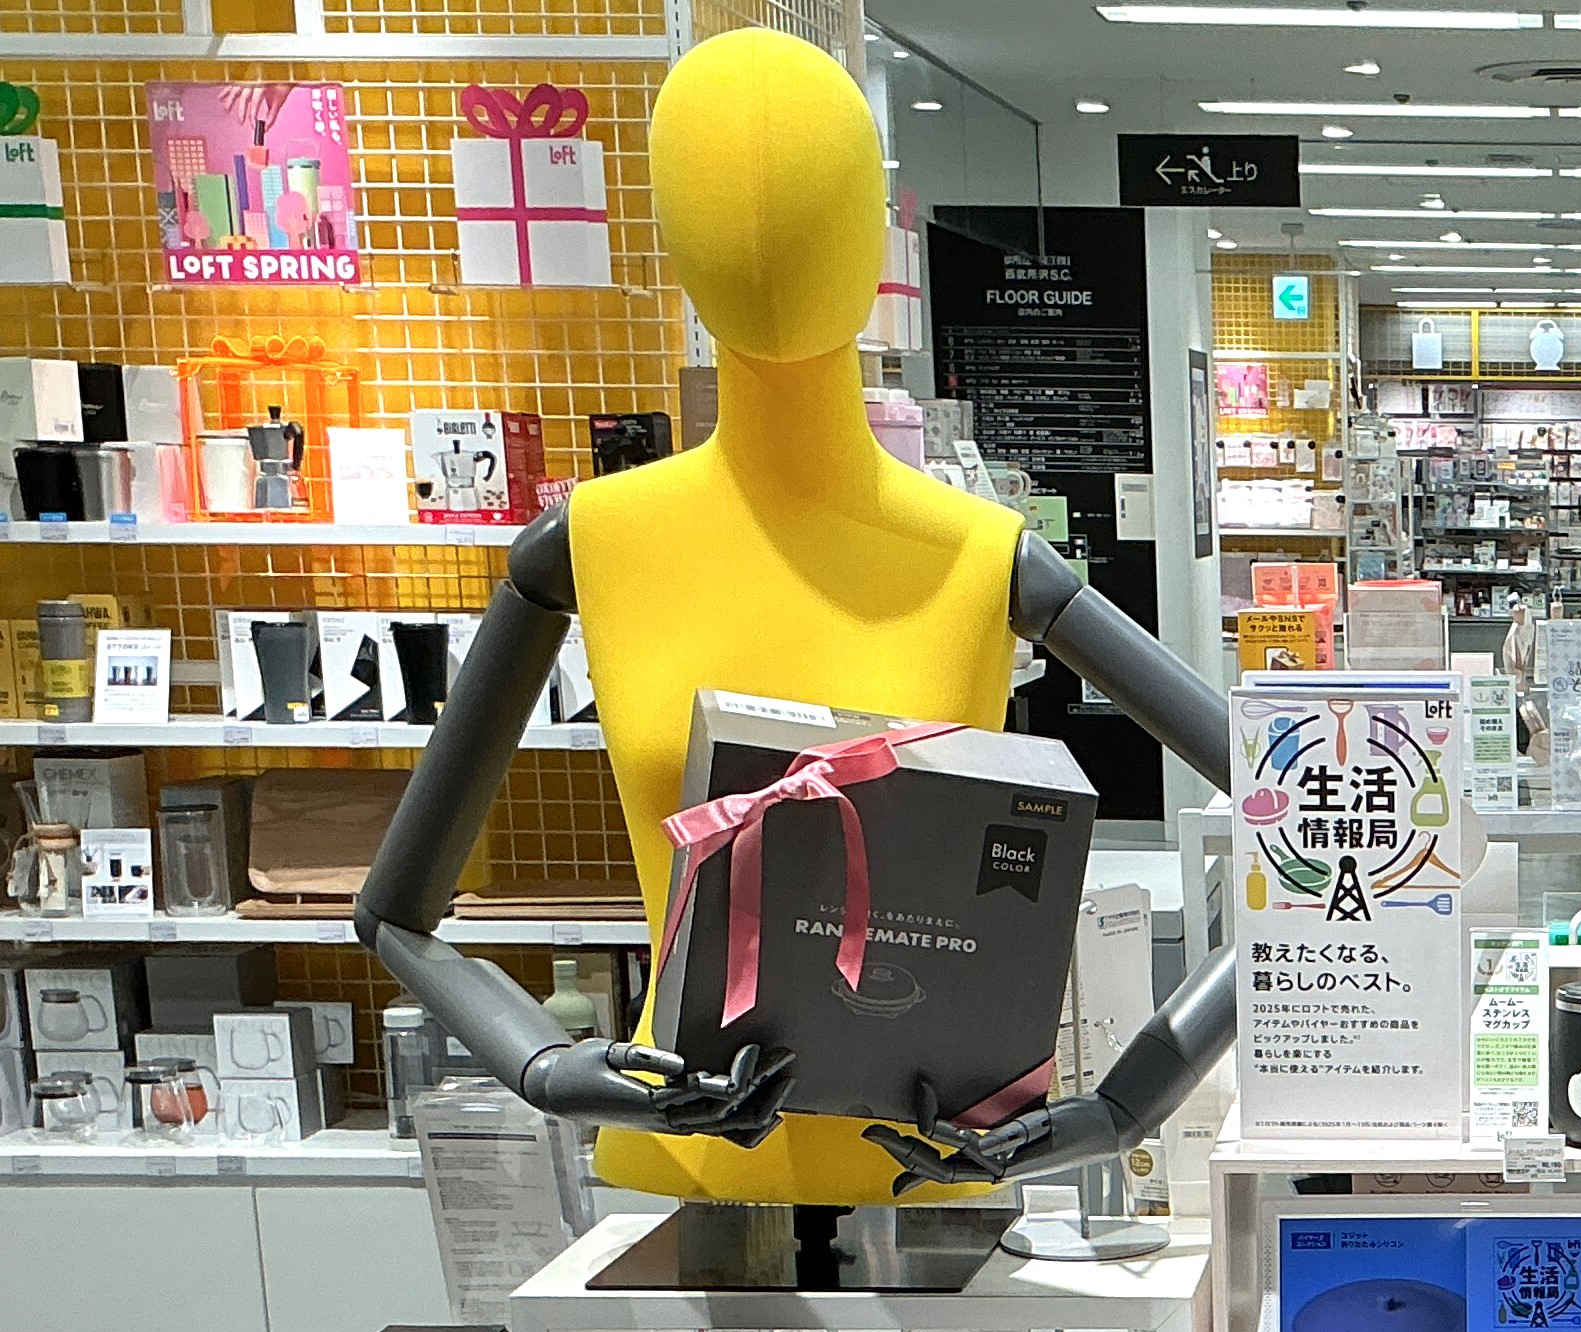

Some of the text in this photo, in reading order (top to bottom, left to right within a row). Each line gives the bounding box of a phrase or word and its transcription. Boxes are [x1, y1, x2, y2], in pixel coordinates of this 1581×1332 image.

[4, 141, 35, 164] Loft
[549, 143, 577, 166] Loft
[1227, 160, 1259, 182] 上り
[169, 255, 355, 281] LOFT SPRING
[986, 289, 1093, 306] FLOOR GUIDE
[1424, 700, 1453, 719] Loft
[43, 767, 97, 781] CHEMEX
[1298, 765, 1398, 813] 生活
[1016, 800, 1064, 817] SAMPLE
[1296, 818, 1398, 850] 情報局
[991, 843, 1037, 864] Black
[992, 862, 1031, 874] COLOR
[795, 920, 977, 954] RANEMATE PRO
[1251, 942, 1391, 965] 教えたくなる、
[1251, 971, 1412, 993] 暮らしのベスト。
[1252, 1003, 1377, 1015] 2025年にロフトで売れた、
[1488, 997, 1525, 1007] ムームー
[1482, 1008, 1530, 1019] ステンレス
[1252, 1019, 1420, 1030] アイテムやバイヤーおすすめの商品を
[1483, 1019, 1531, 1030] マグカップ
[1253, 1048, 1333, 1059] 暮らしを楽にする
[1519, 1265, 1560, 1286] 生活
[1518, 1285, 1561, 1300] 情報局
